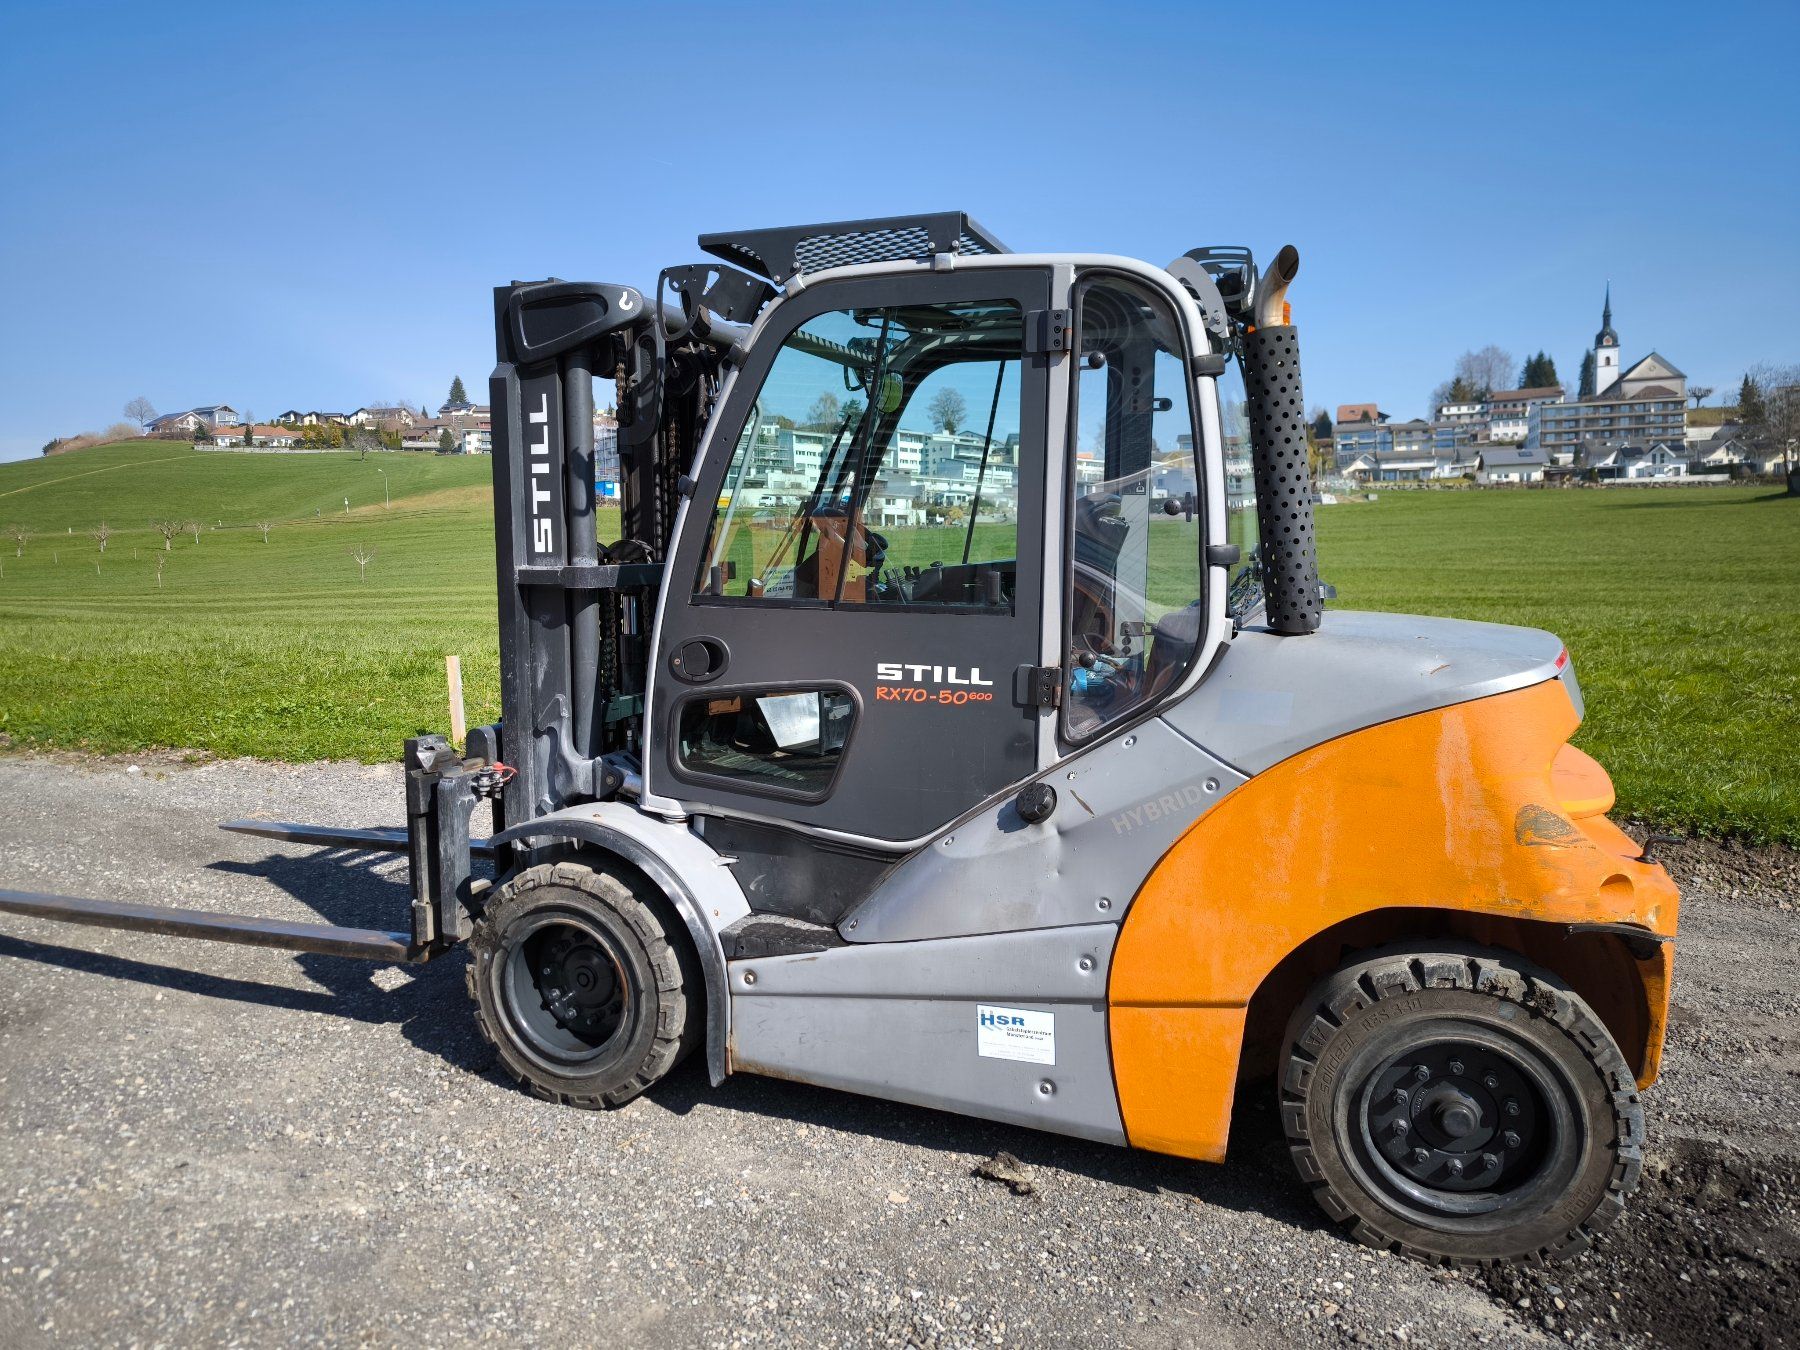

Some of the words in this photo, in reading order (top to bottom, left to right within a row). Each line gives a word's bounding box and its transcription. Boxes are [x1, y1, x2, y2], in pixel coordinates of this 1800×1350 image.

[529, 393, 553, 553] STILL
[876, 662, 993, 686] STILL
[1110, 784, 1202, 834] HYBRID
[980, 1012, 1025, 1027] HSR
